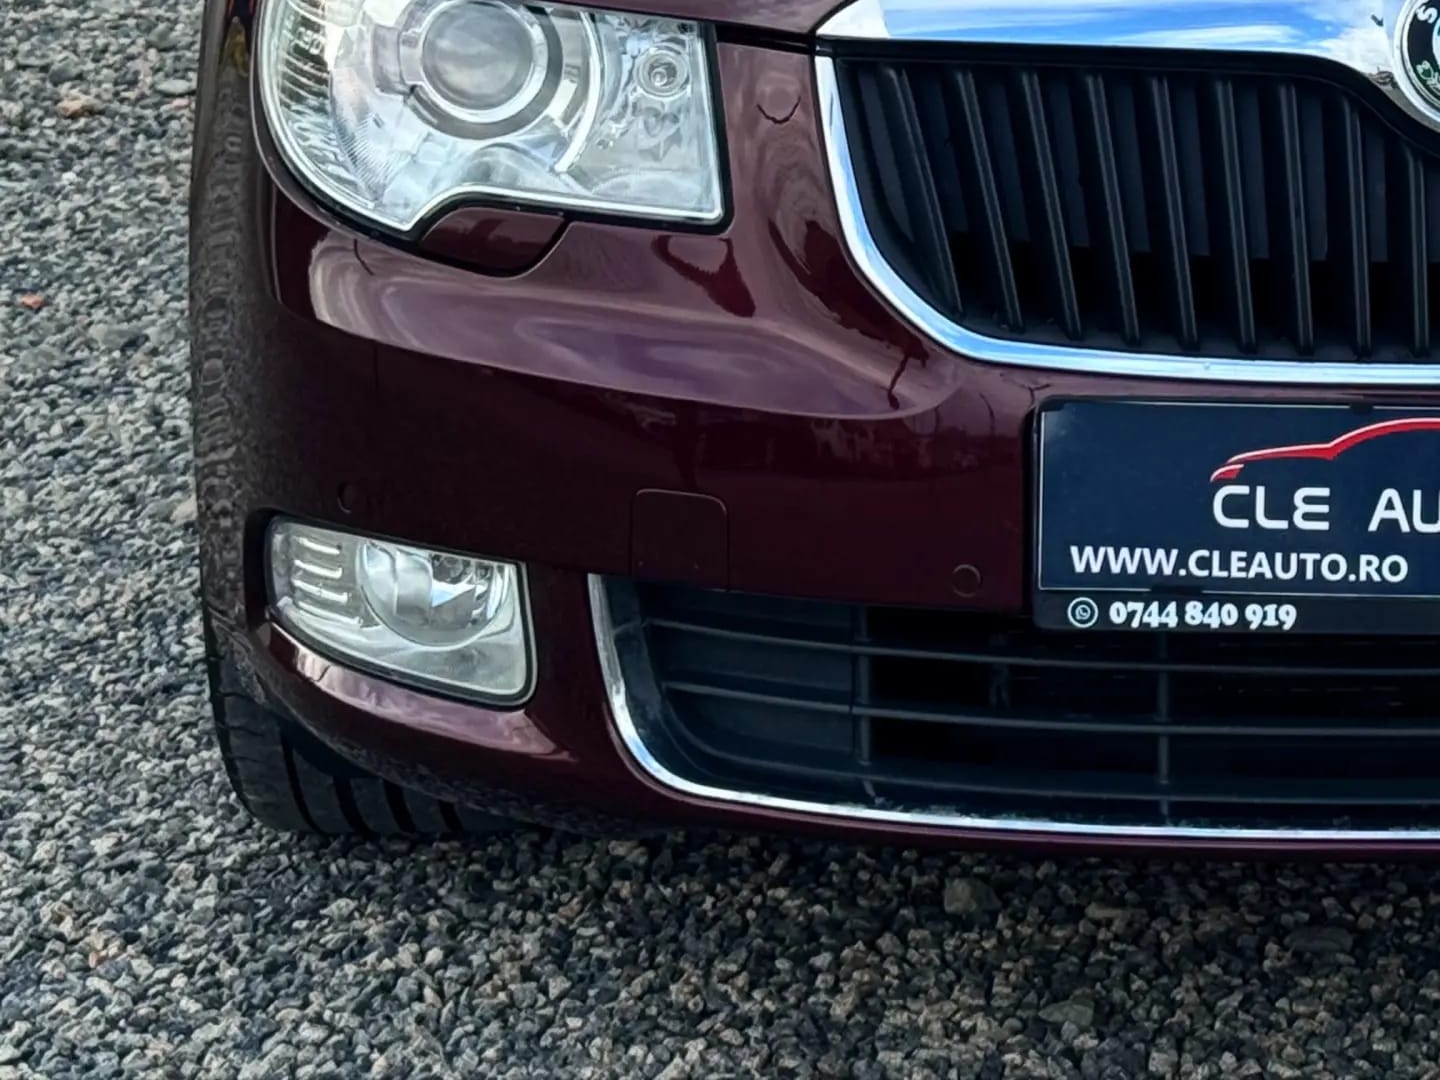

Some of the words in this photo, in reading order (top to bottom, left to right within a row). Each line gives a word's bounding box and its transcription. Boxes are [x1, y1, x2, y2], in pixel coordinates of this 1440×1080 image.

[1213, 485, 1331, 531] CLE
[1069, 545, 1409, 583] WWW.CLEAUTO.RO
[1109, 600, 1179, 629] 0744
[1184, 600, 1239, 629] 840
[1244, 603, 1297, 631] 919
